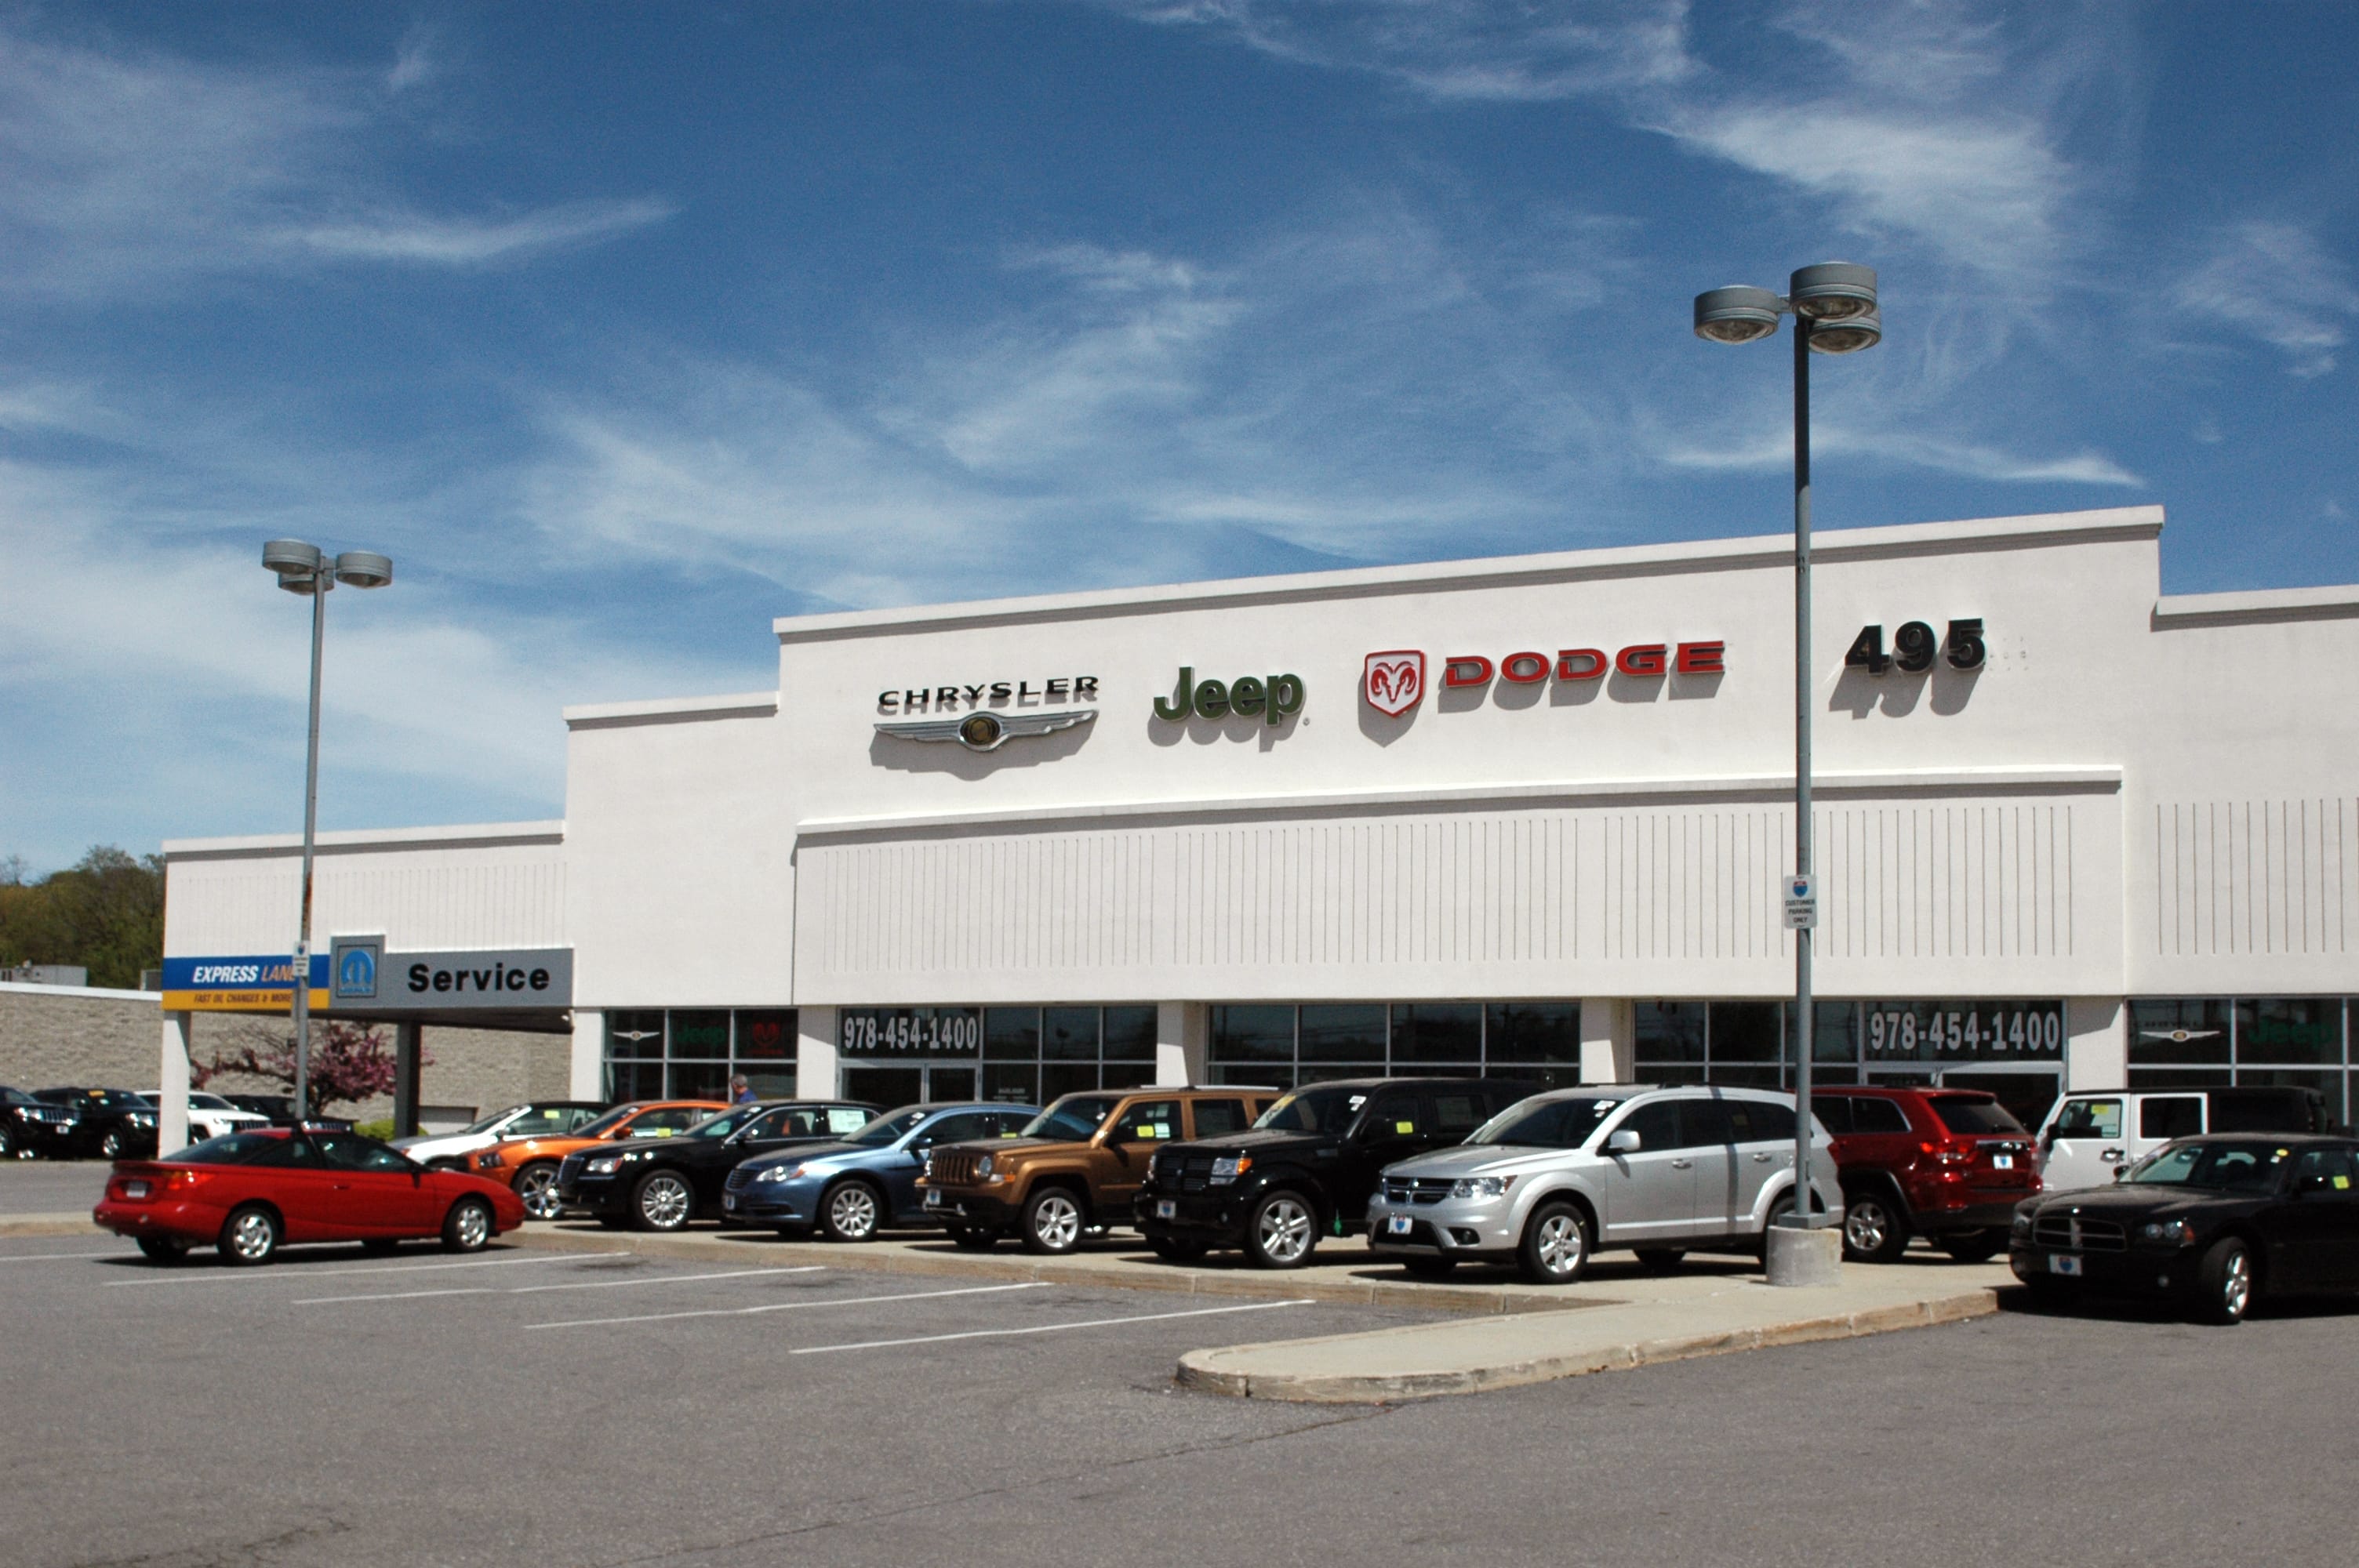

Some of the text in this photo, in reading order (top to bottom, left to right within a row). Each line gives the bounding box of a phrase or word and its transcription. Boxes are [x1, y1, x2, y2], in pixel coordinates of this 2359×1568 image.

[1845, 619, 1986, 675] 495
[1445, 641, 1725, 688] DODGE
[878, 676, 1098, 706] CHRYSLER
[1154, 666, 1305, 727] Jeep
[193, 965, 259, 983] EXPRESS
[408, 962, 550, 993] Service
[194, 993, 211, 1003] FAST
[227, 993, 260, 1003] CHANGES
[845, 1017, 978, 1050] 978-454-1400
[1870, 1011, 2059, 1051] 978-454-1400
[2248, 1015, 2335, 1049] Jeep
